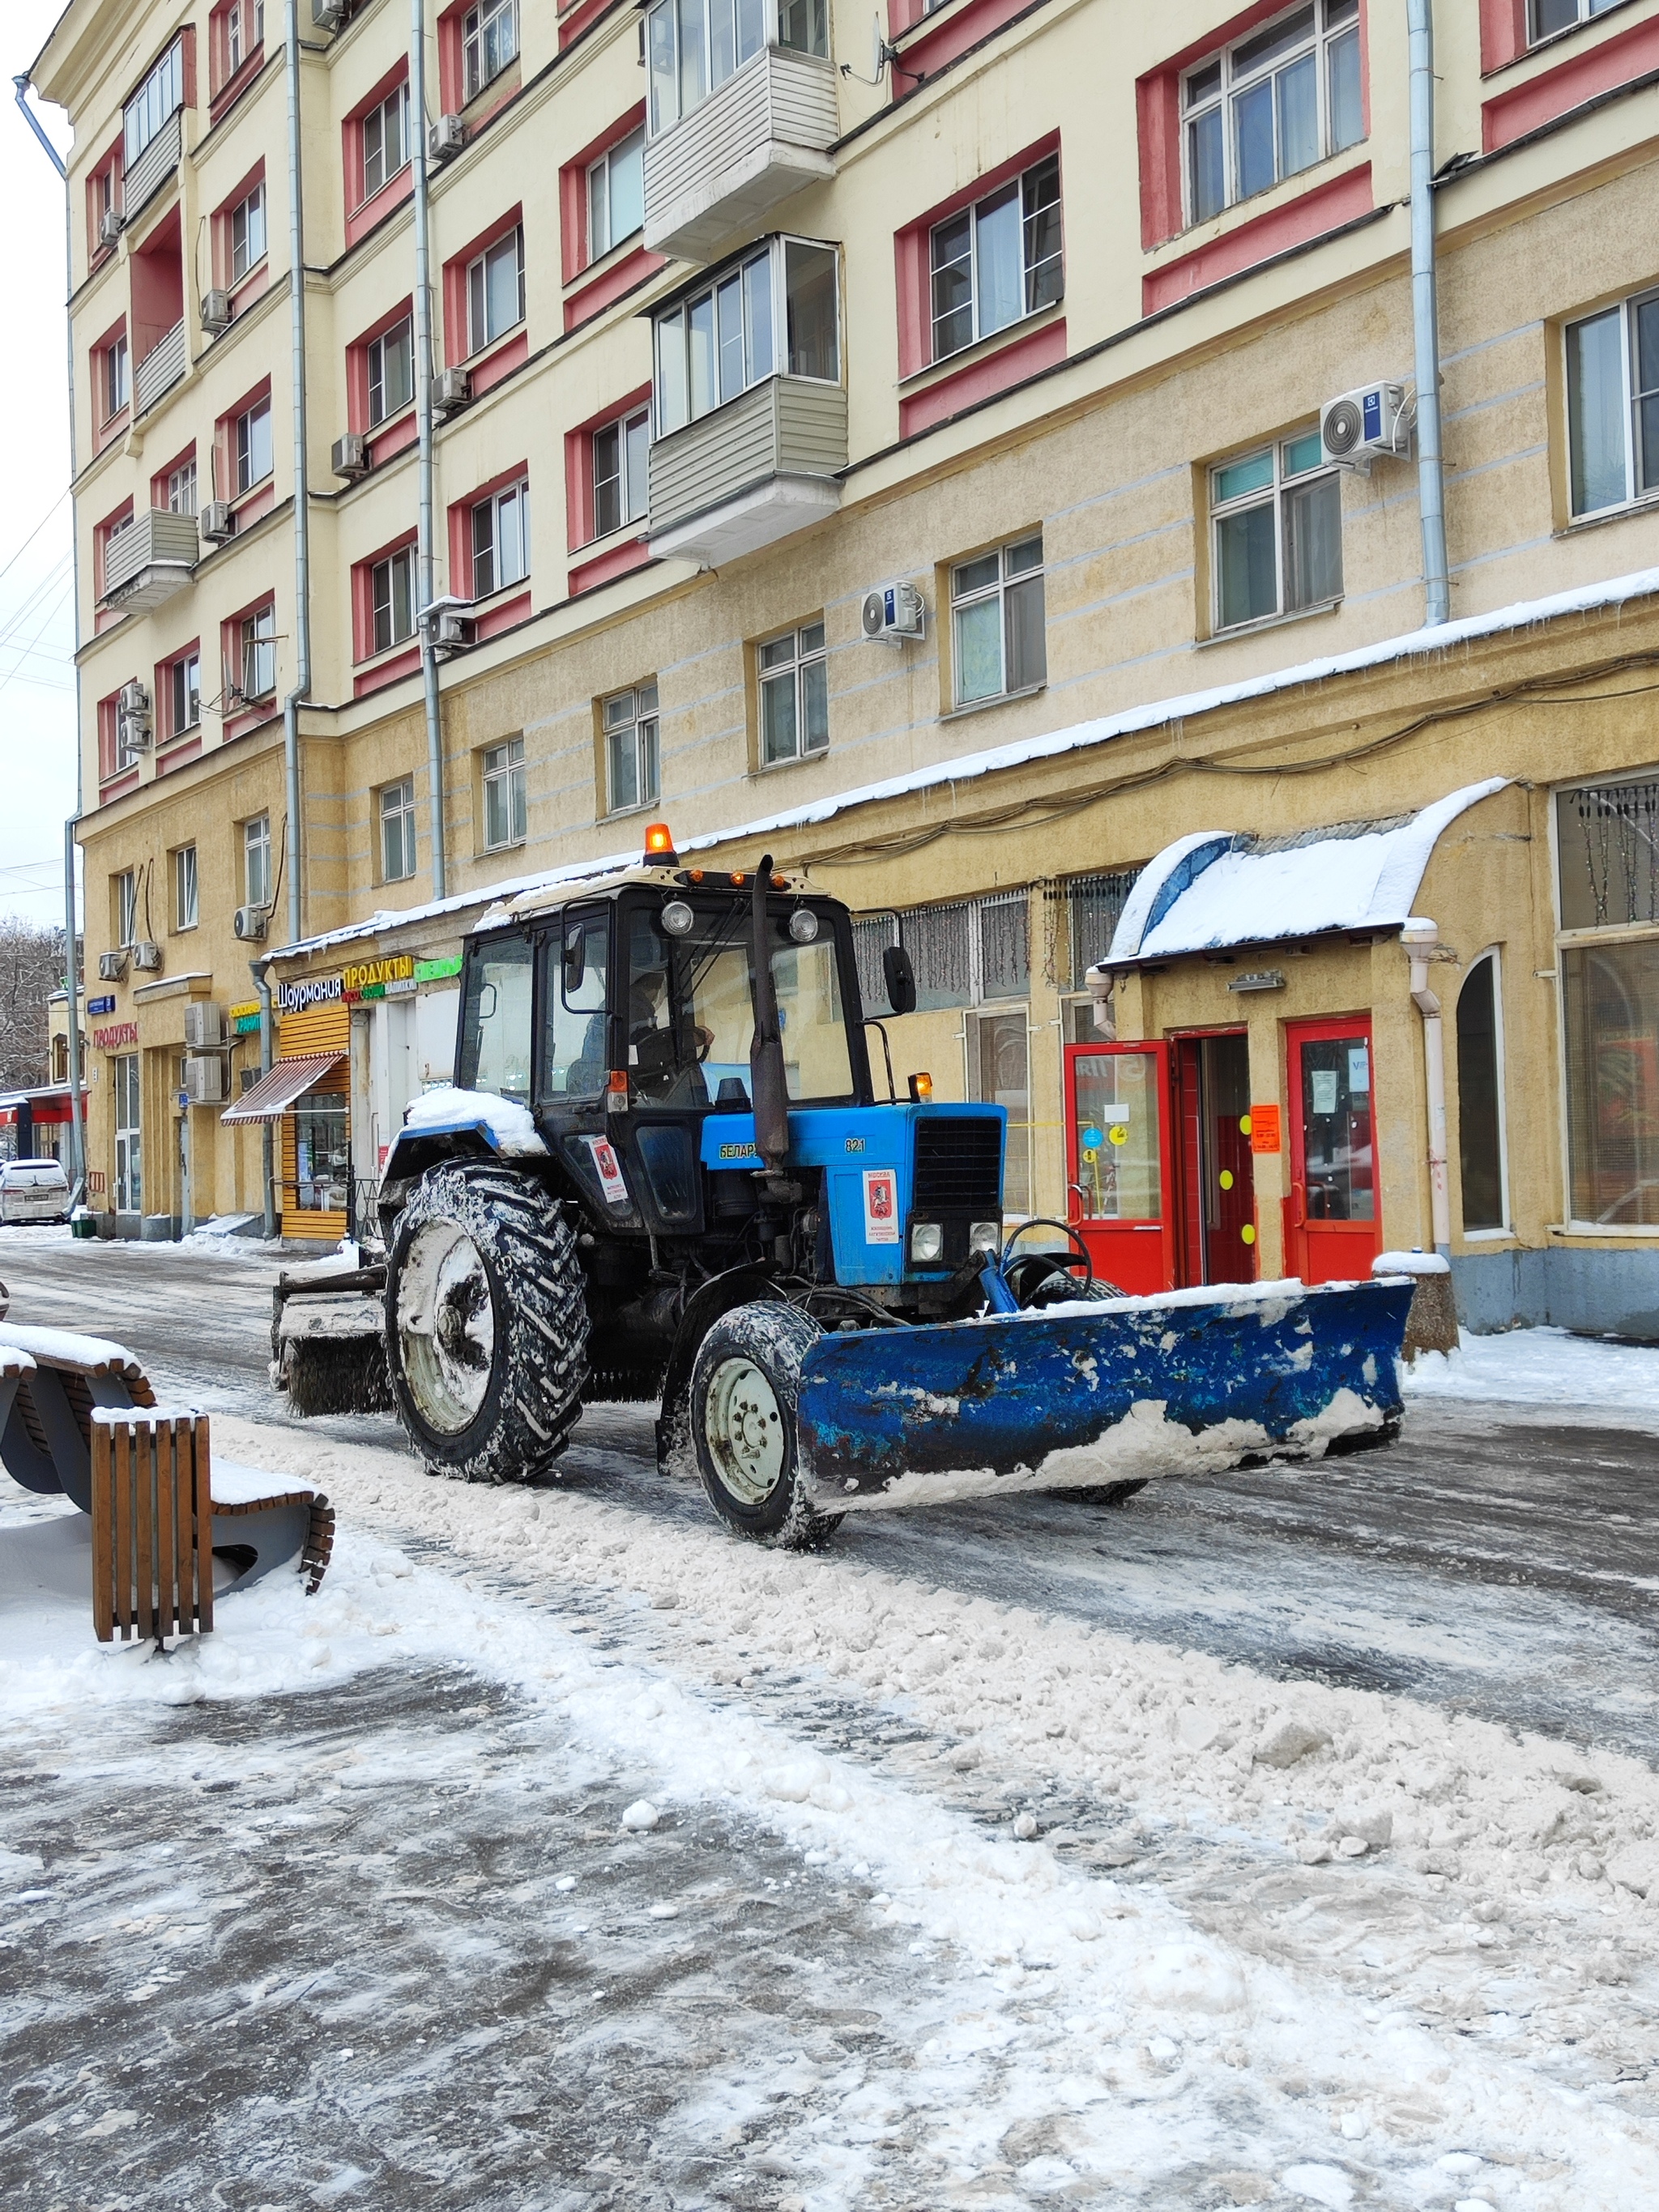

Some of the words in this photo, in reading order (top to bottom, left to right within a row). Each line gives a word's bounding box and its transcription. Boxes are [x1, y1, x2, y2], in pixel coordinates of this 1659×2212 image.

[343, 956, 412, 990] ПРОДУКТЫ
[278, 978, 341, 1012] Шаурмания
[93, 1021, 138, 1050] ПРОДУКТЫ
[719, 1142, 758, 1159] БЕЛАР
